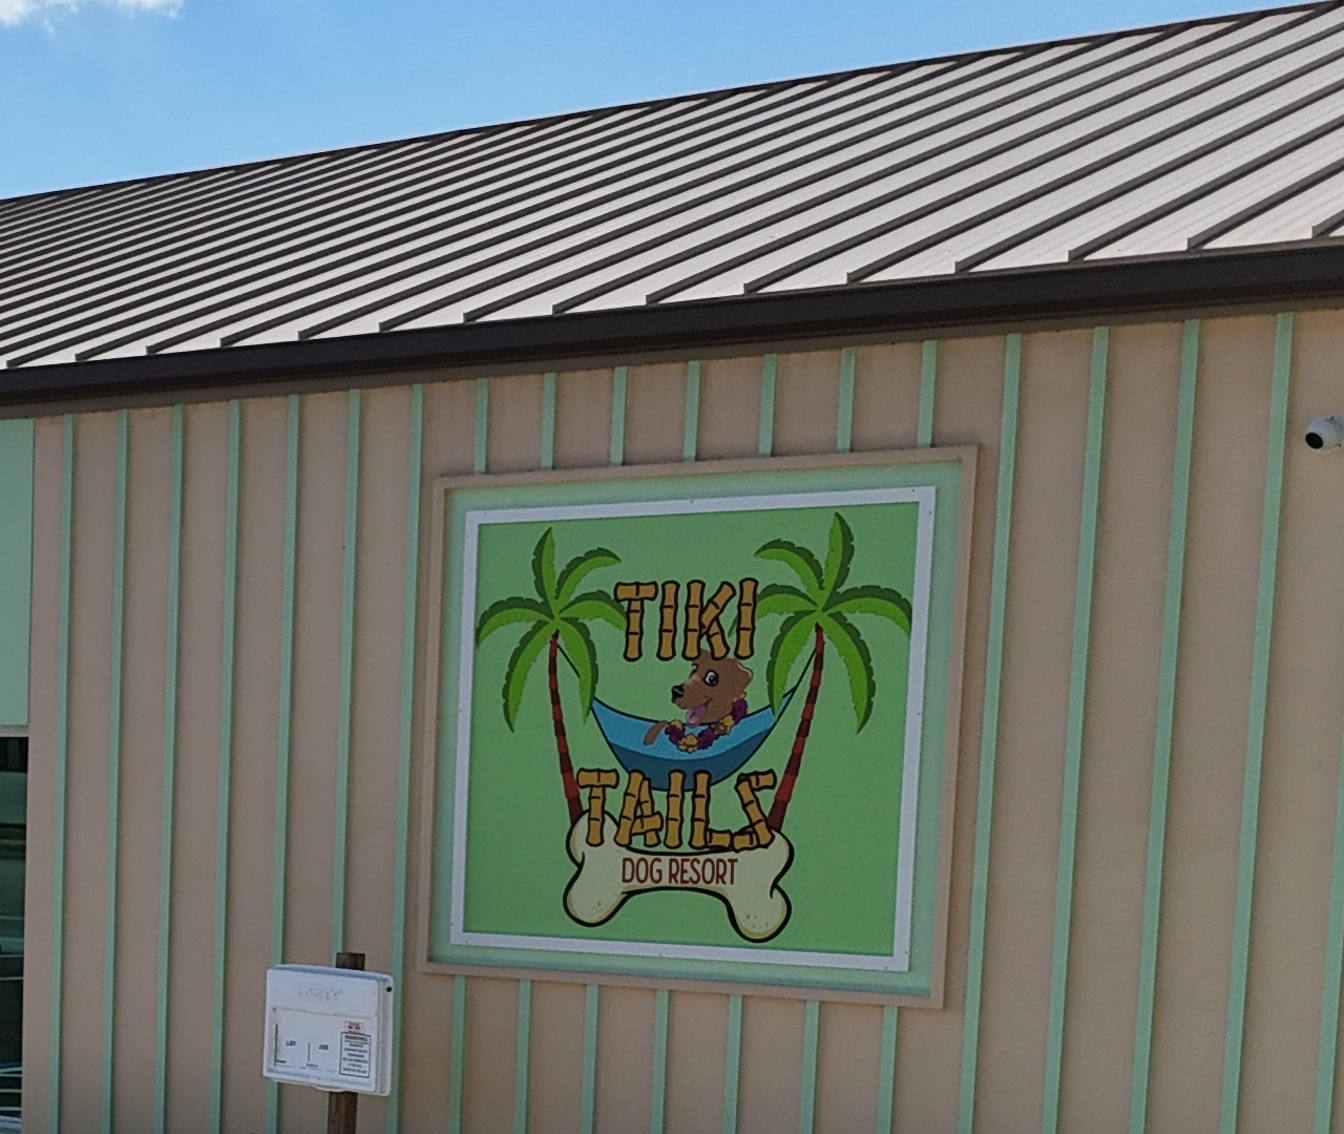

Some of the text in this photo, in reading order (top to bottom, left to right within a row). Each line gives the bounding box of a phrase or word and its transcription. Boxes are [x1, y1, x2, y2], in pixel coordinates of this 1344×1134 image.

[614, 577, 759, 662] TIKI
[576, 767, 777, 853] TAILS
[622, 857, 738, 885] DOG RESORT
